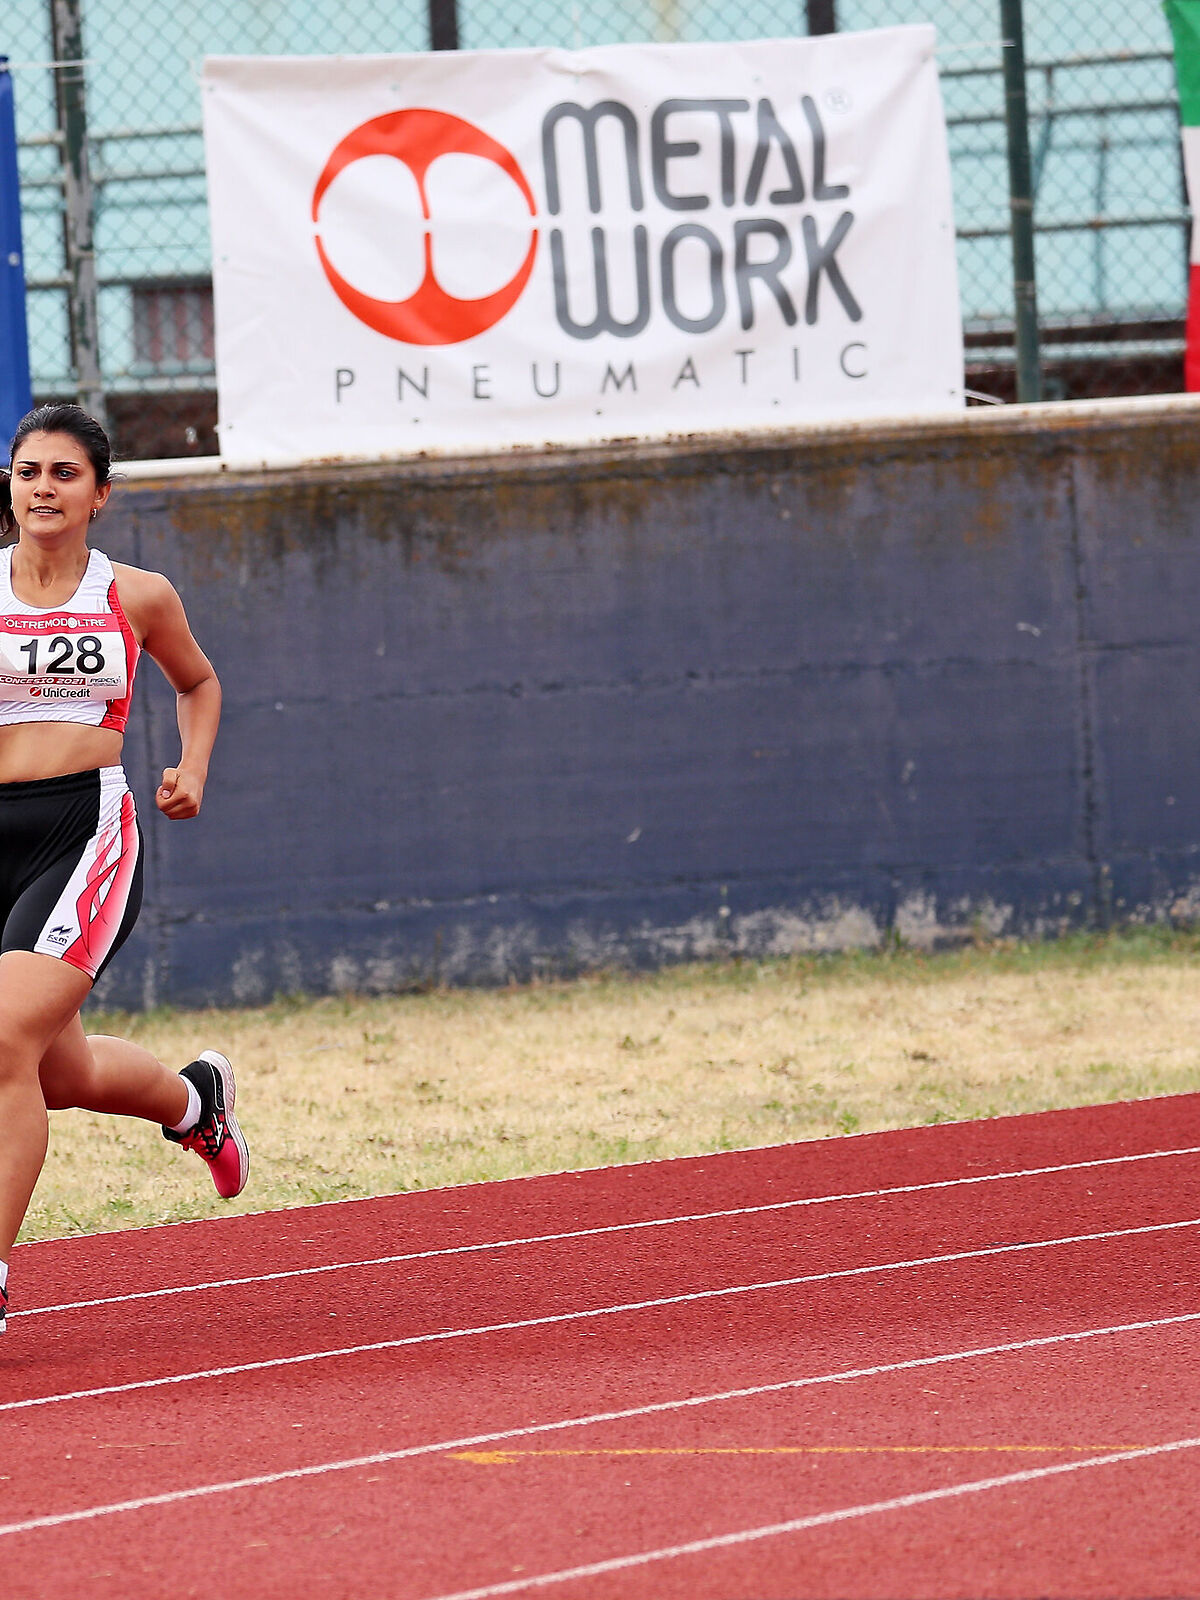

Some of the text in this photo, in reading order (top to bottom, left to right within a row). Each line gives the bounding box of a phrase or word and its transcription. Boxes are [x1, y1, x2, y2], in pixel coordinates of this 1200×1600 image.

[540, 95, 850, 217] METAL
[549, 209, 864, 341] WORK
[335, 342, 870, 403] PNEUMATIC
[20, 635, 106, 675] 128
[41, 686, 91, 699] UniCredit
